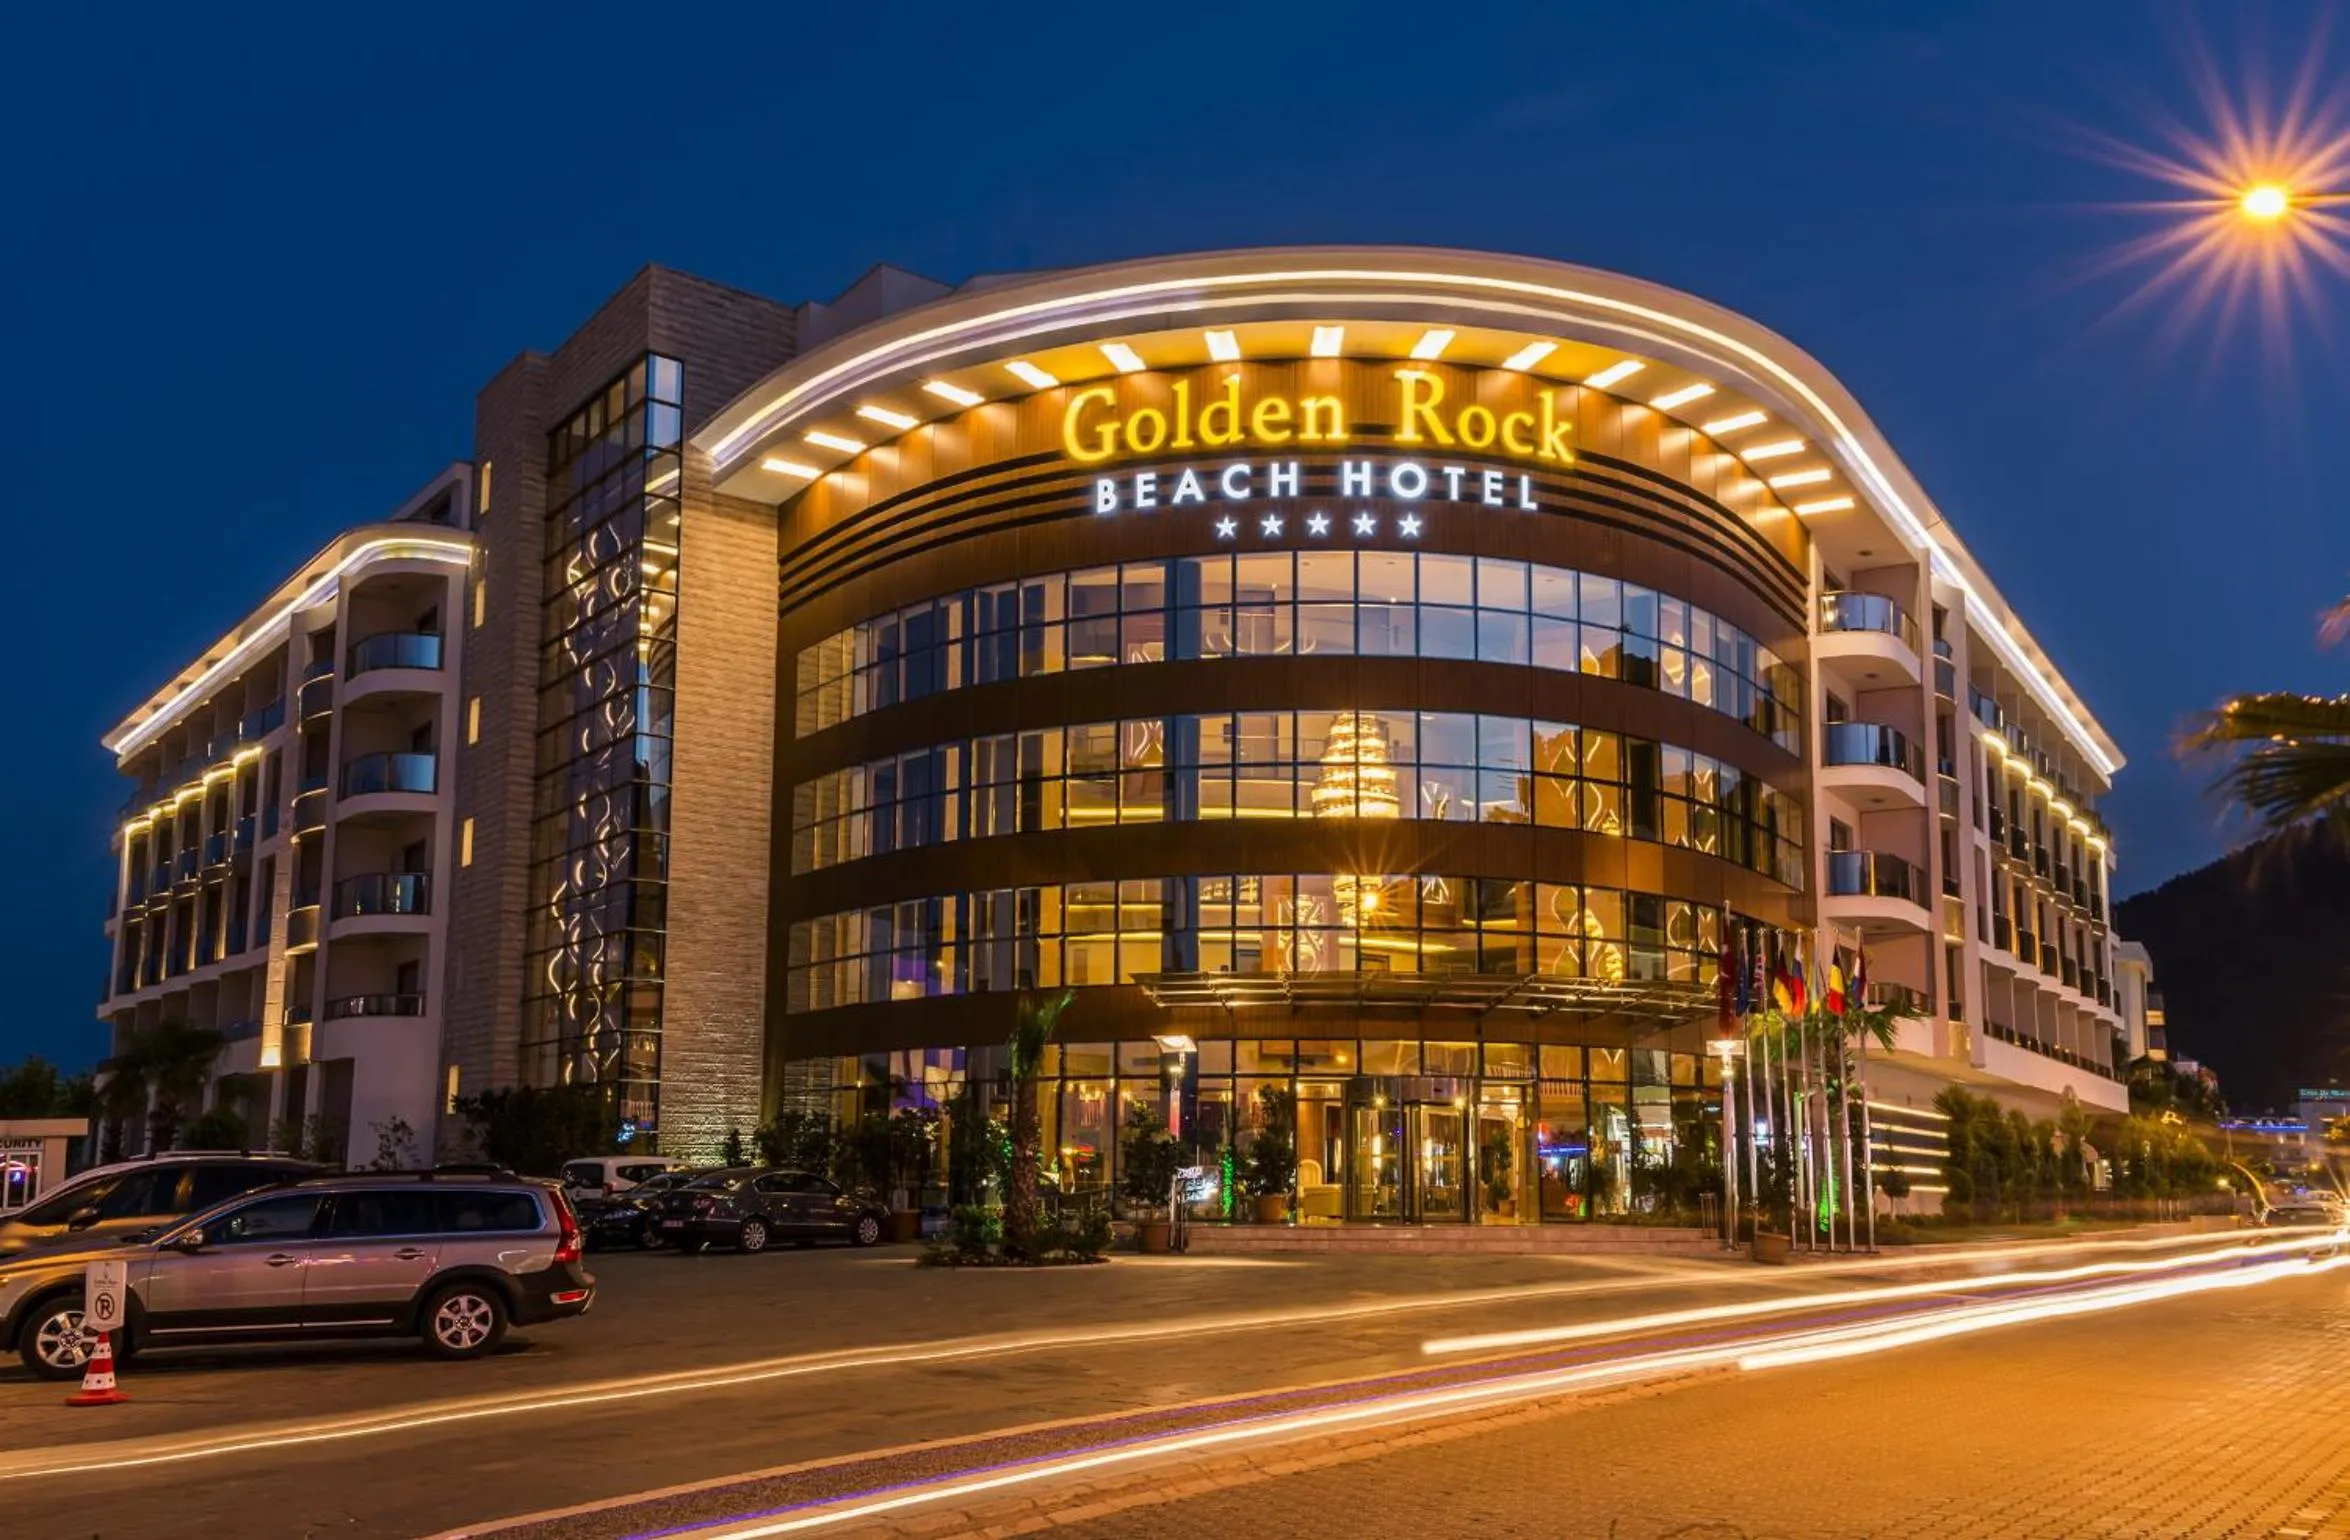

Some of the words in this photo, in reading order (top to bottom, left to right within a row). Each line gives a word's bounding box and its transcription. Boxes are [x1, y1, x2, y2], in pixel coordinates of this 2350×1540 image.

[1063, 374, 1349, 461] Golden
[1394, 369, 1574, 463] Rock
[1096, 461, 1299, 514] BEACH
[1342, 460, 1538, 510] HOTEL
